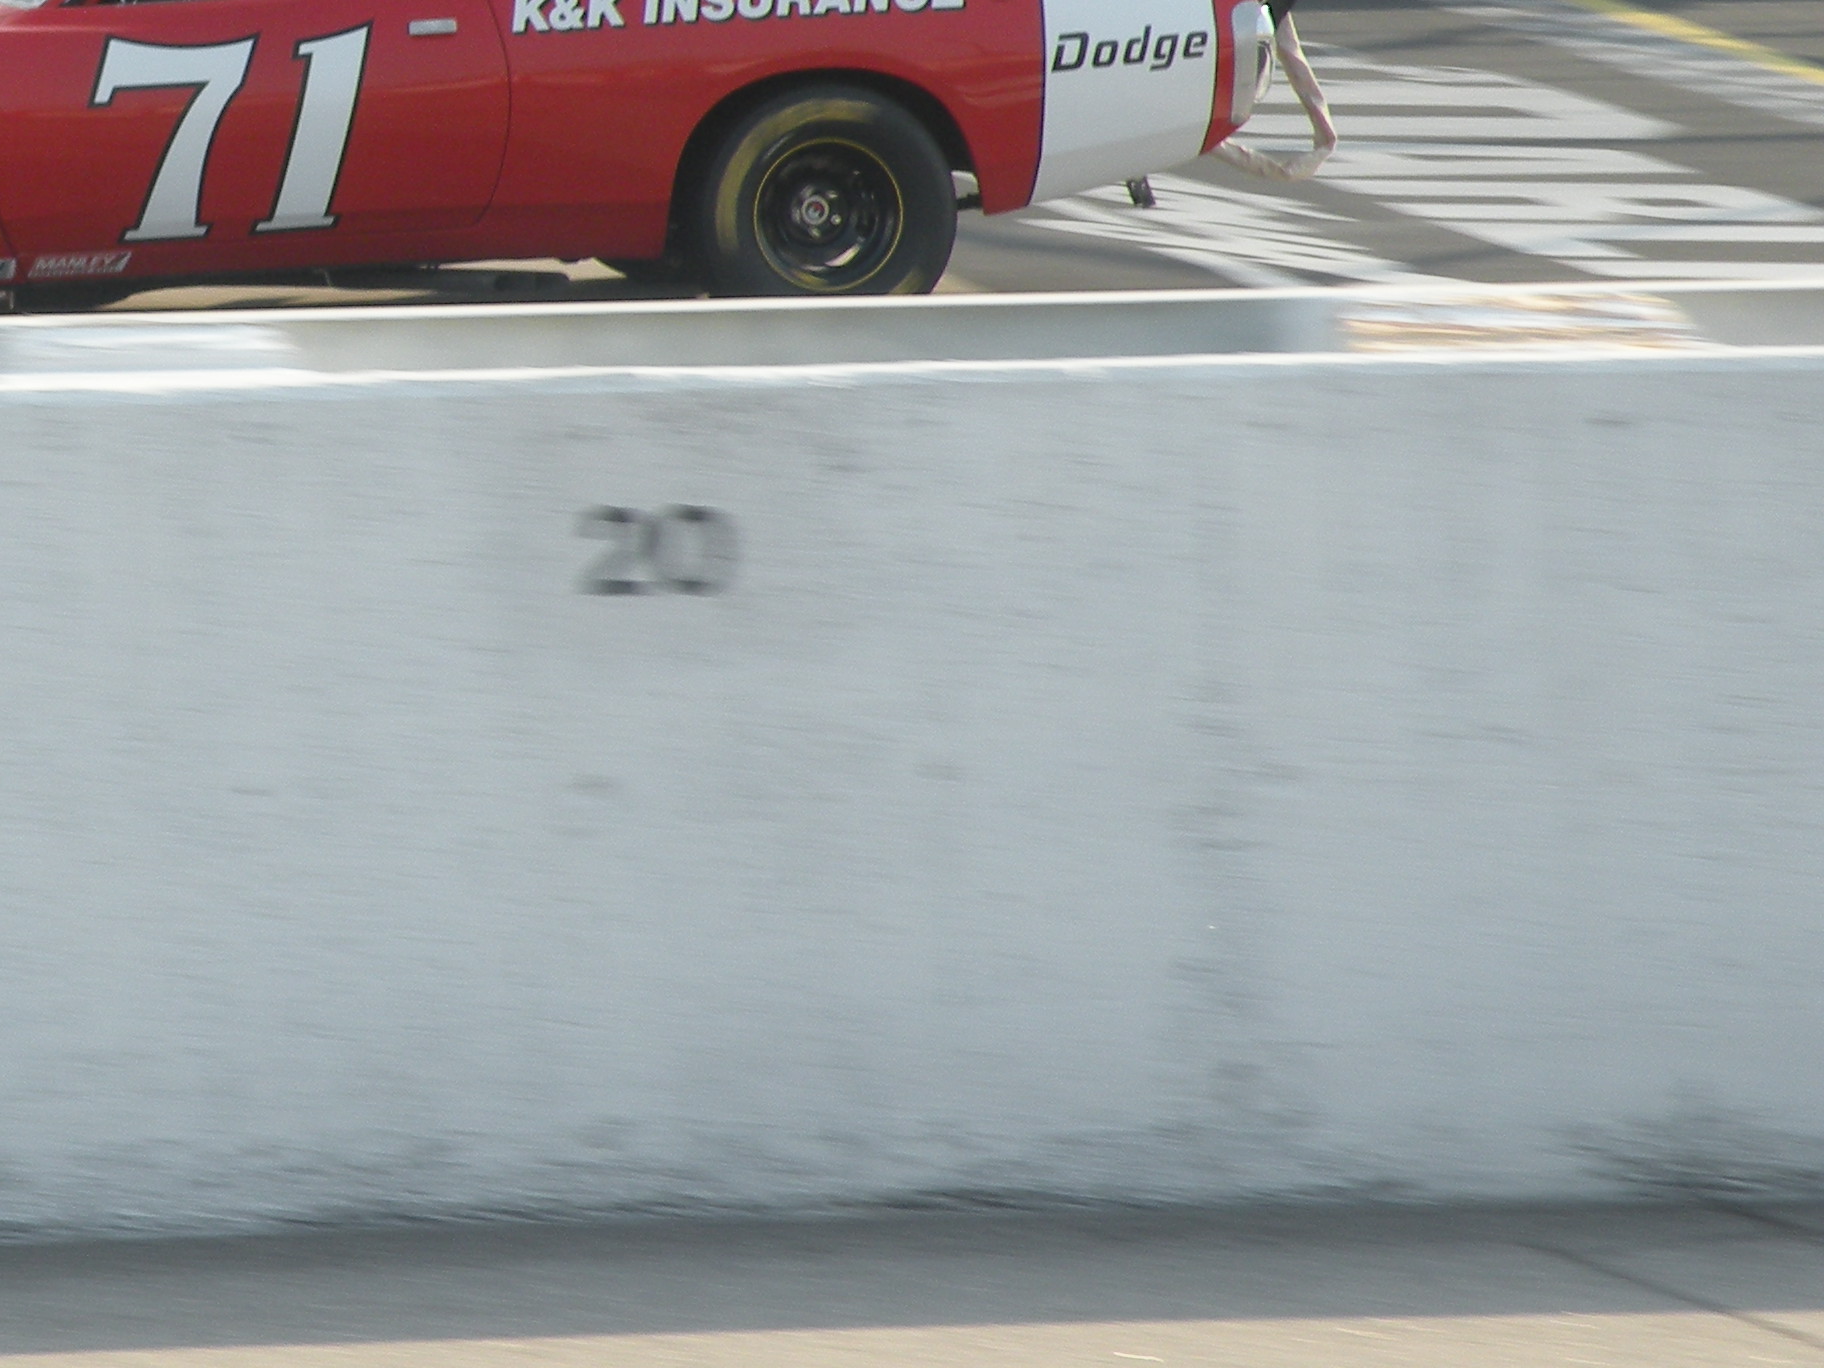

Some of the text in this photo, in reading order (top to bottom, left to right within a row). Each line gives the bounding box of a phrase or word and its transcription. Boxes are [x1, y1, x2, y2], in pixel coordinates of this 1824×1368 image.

[1051, 25, 1210, 72] Dodge
[87, 22, 373, 243] 71
[576, 503, 738, 596] 20
